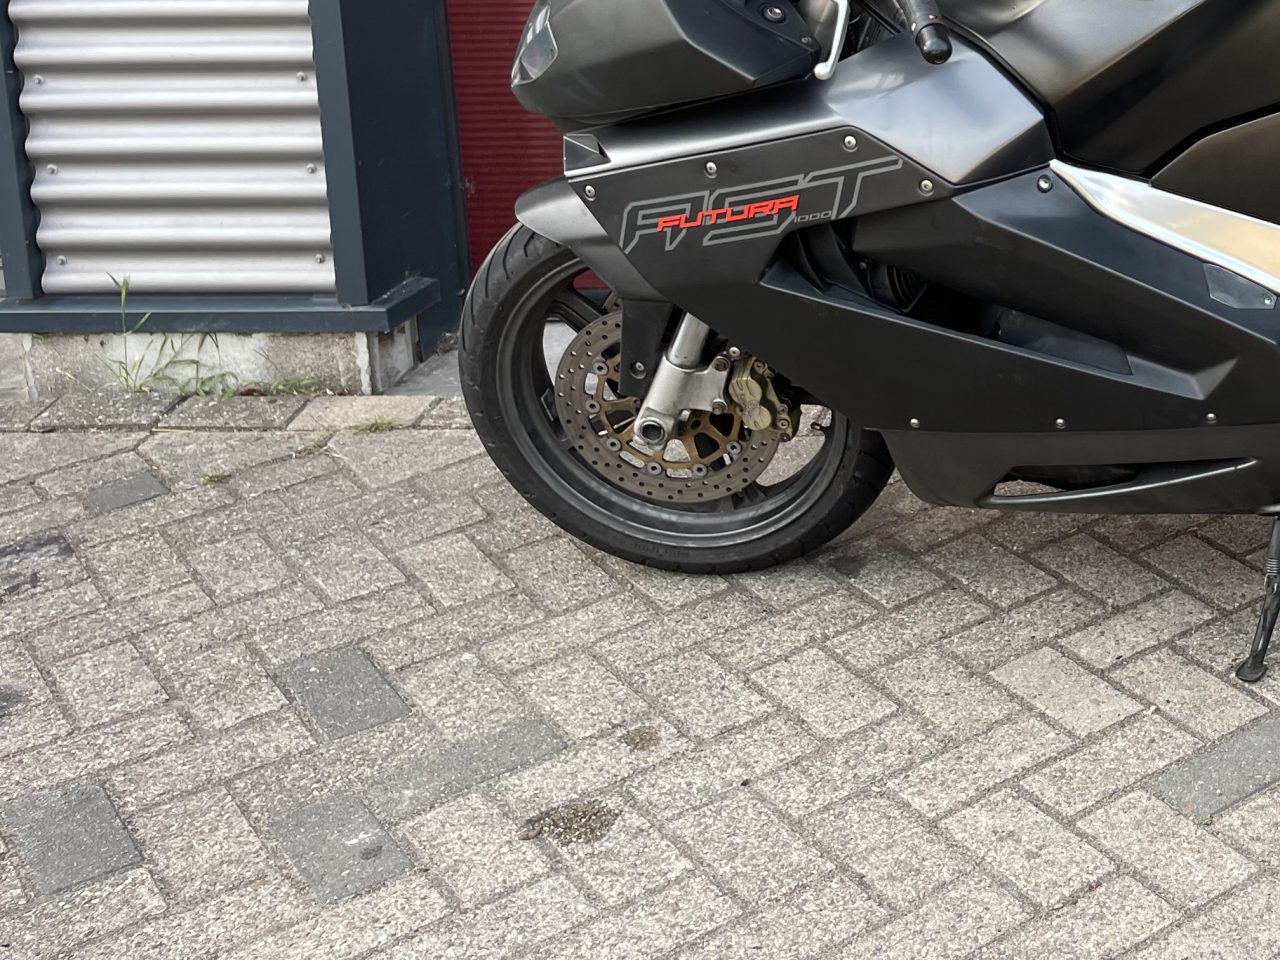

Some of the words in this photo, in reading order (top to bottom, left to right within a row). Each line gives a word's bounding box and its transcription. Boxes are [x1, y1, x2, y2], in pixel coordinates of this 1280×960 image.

[619, 155, 904, 254] RST
[656, 194, 800, 231] FUTURA
[794, 210, 832, 223] 1000
